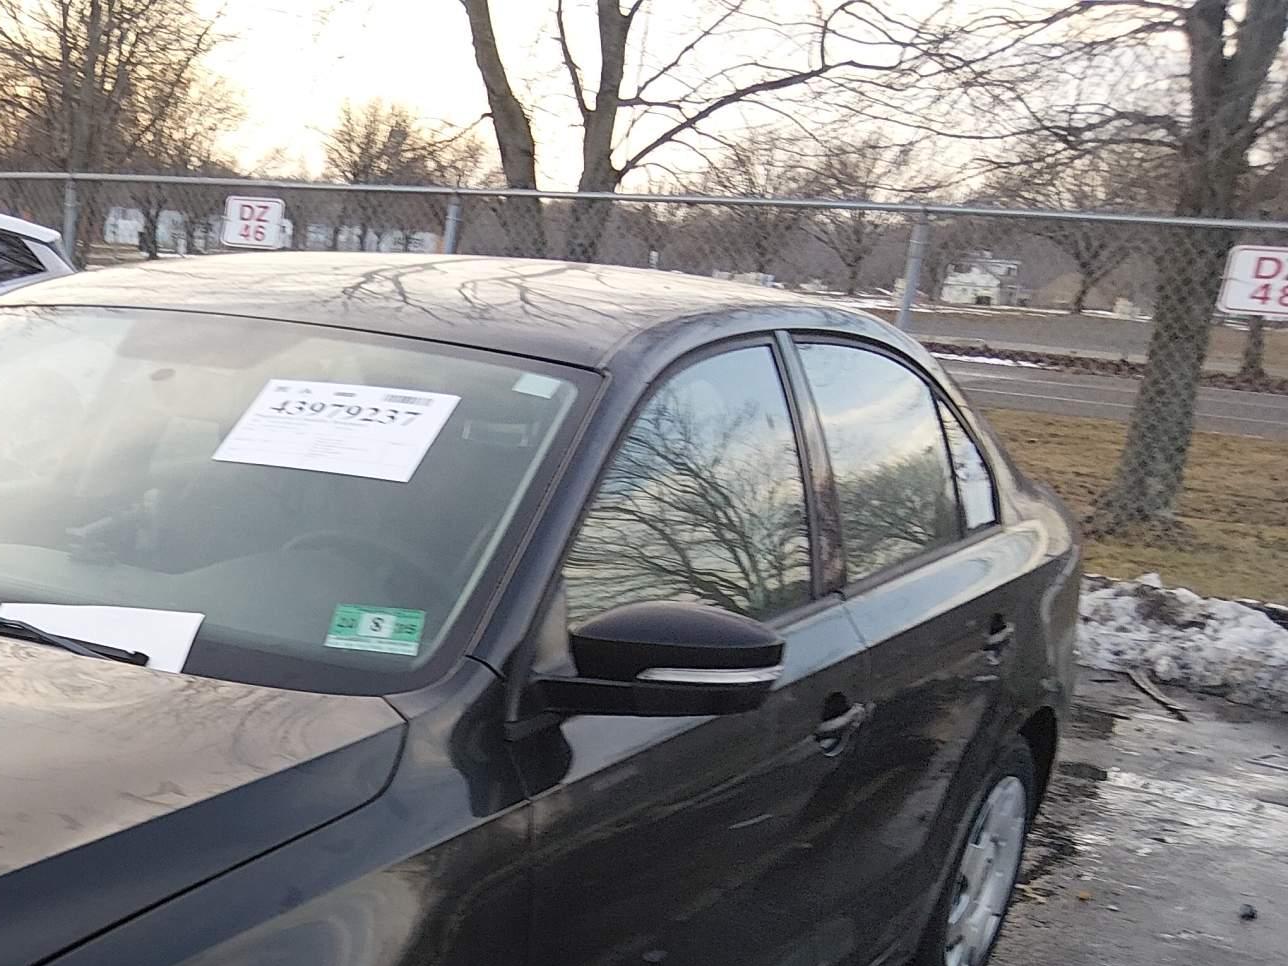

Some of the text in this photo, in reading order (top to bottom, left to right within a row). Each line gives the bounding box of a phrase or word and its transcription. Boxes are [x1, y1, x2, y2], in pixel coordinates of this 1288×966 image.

[239, 204, 270, 223] DZ
[239, 224, 266, 242] 46
[1254, 256, 1288, 280] D
[270, 400, 423, 426] 43979237
